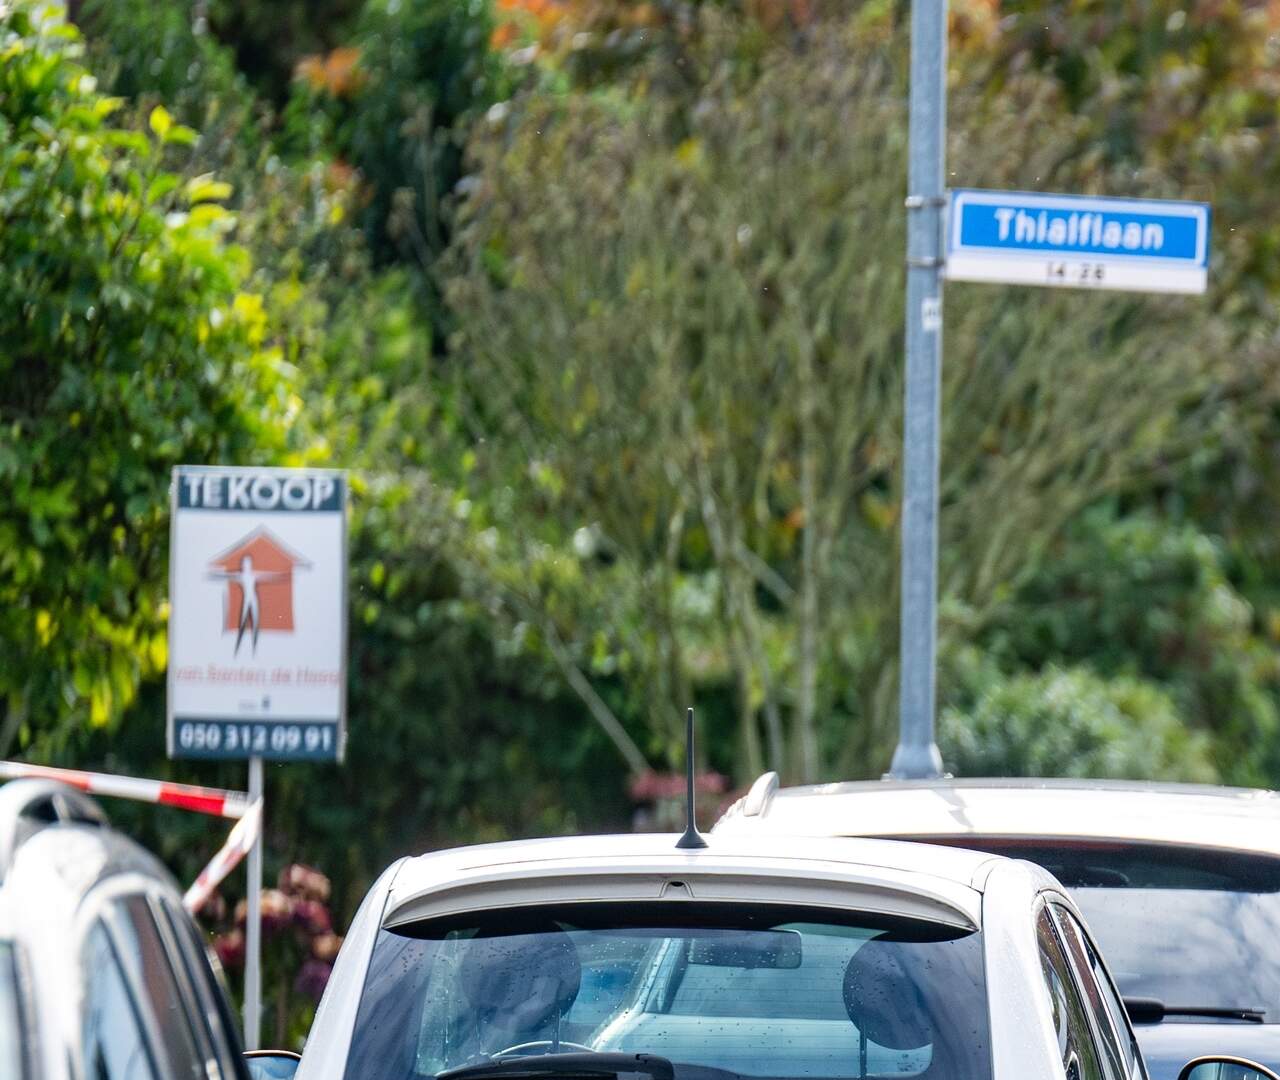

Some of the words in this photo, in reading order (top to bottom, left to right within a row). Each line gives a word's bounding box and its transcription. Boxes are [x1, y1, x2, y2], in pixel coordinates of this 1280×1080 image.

[993, 206, 1165, 250] Thialflaan
[185, 474, 222, 507] TE
[228, 475, 335, 510] KOOP
[180, 722, 222, 750] 050
[225, 724, 268, 751] 312
[271, 725, 301, 751] 09
[304, 725, 332, 751] 91
